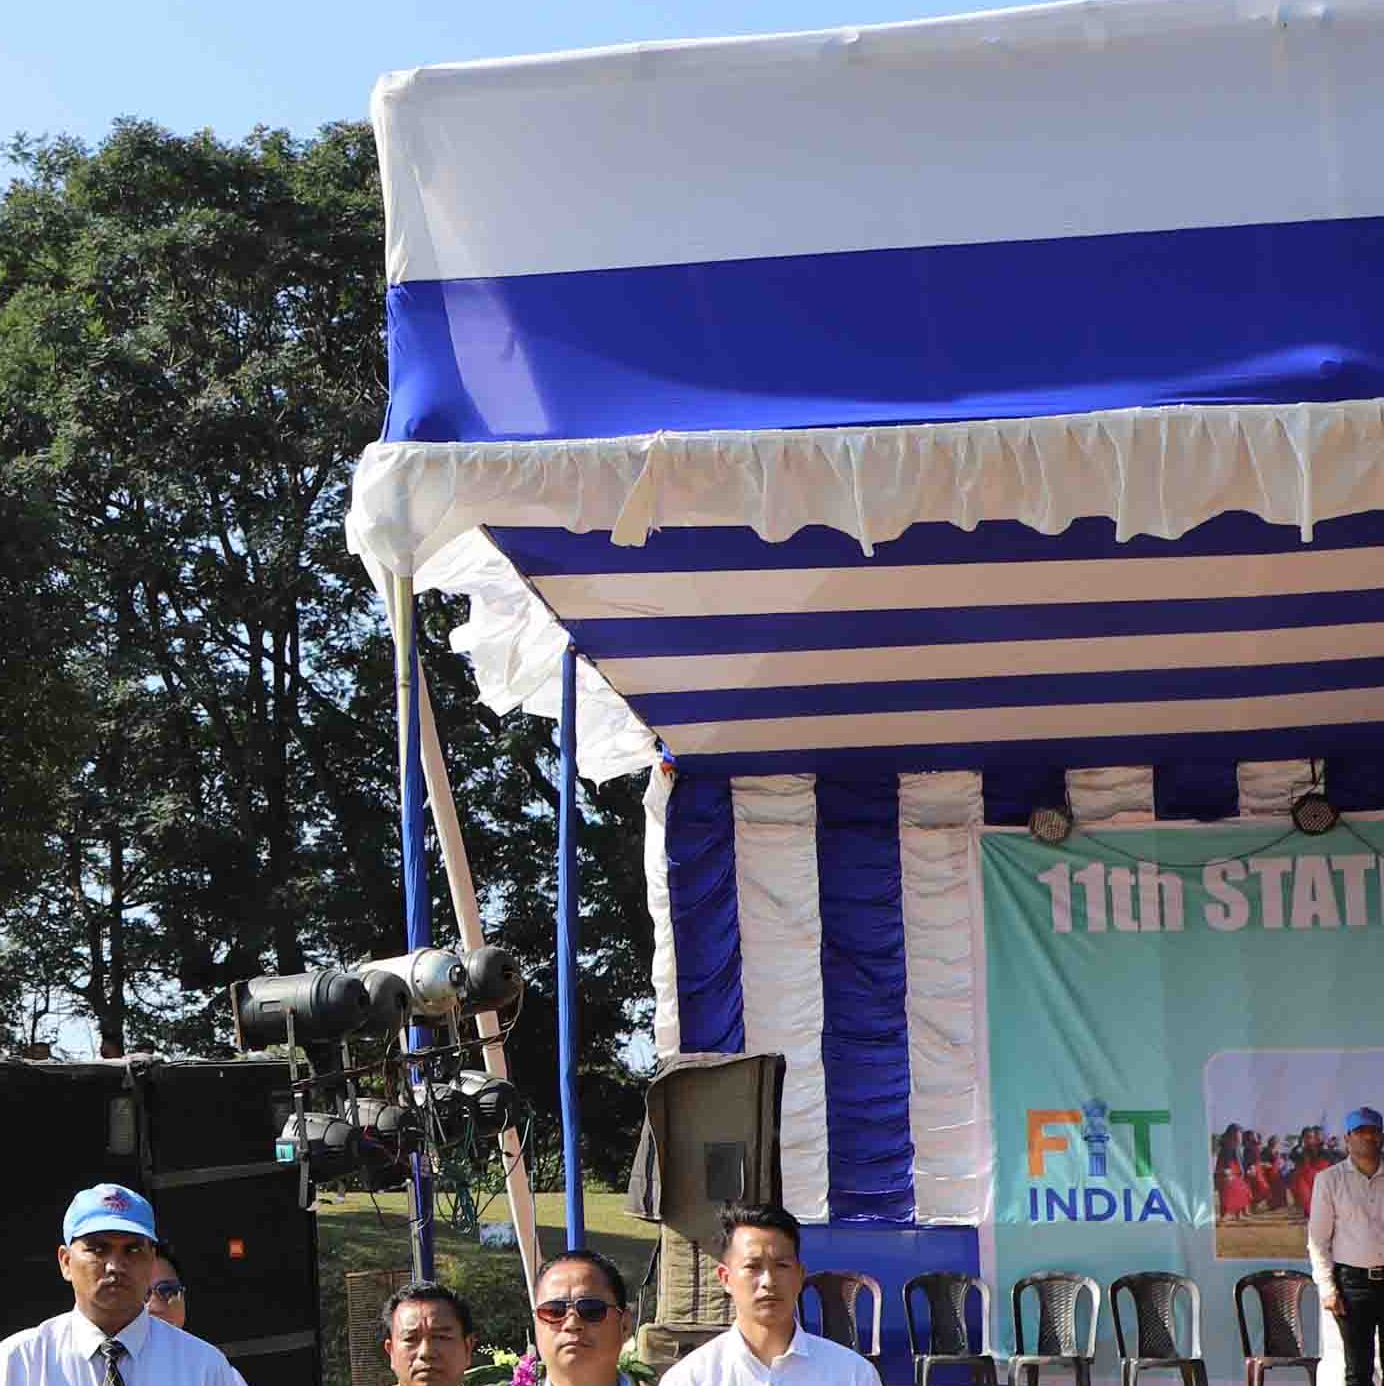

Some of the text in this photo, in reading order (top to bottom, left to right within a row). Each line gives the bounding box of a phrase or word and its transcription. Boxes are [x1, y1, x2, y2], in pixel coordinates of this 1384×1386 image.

[1037, 853, 1384, 934] 11th STAT
[1030, 1187, 1175, 1222] INDIA
